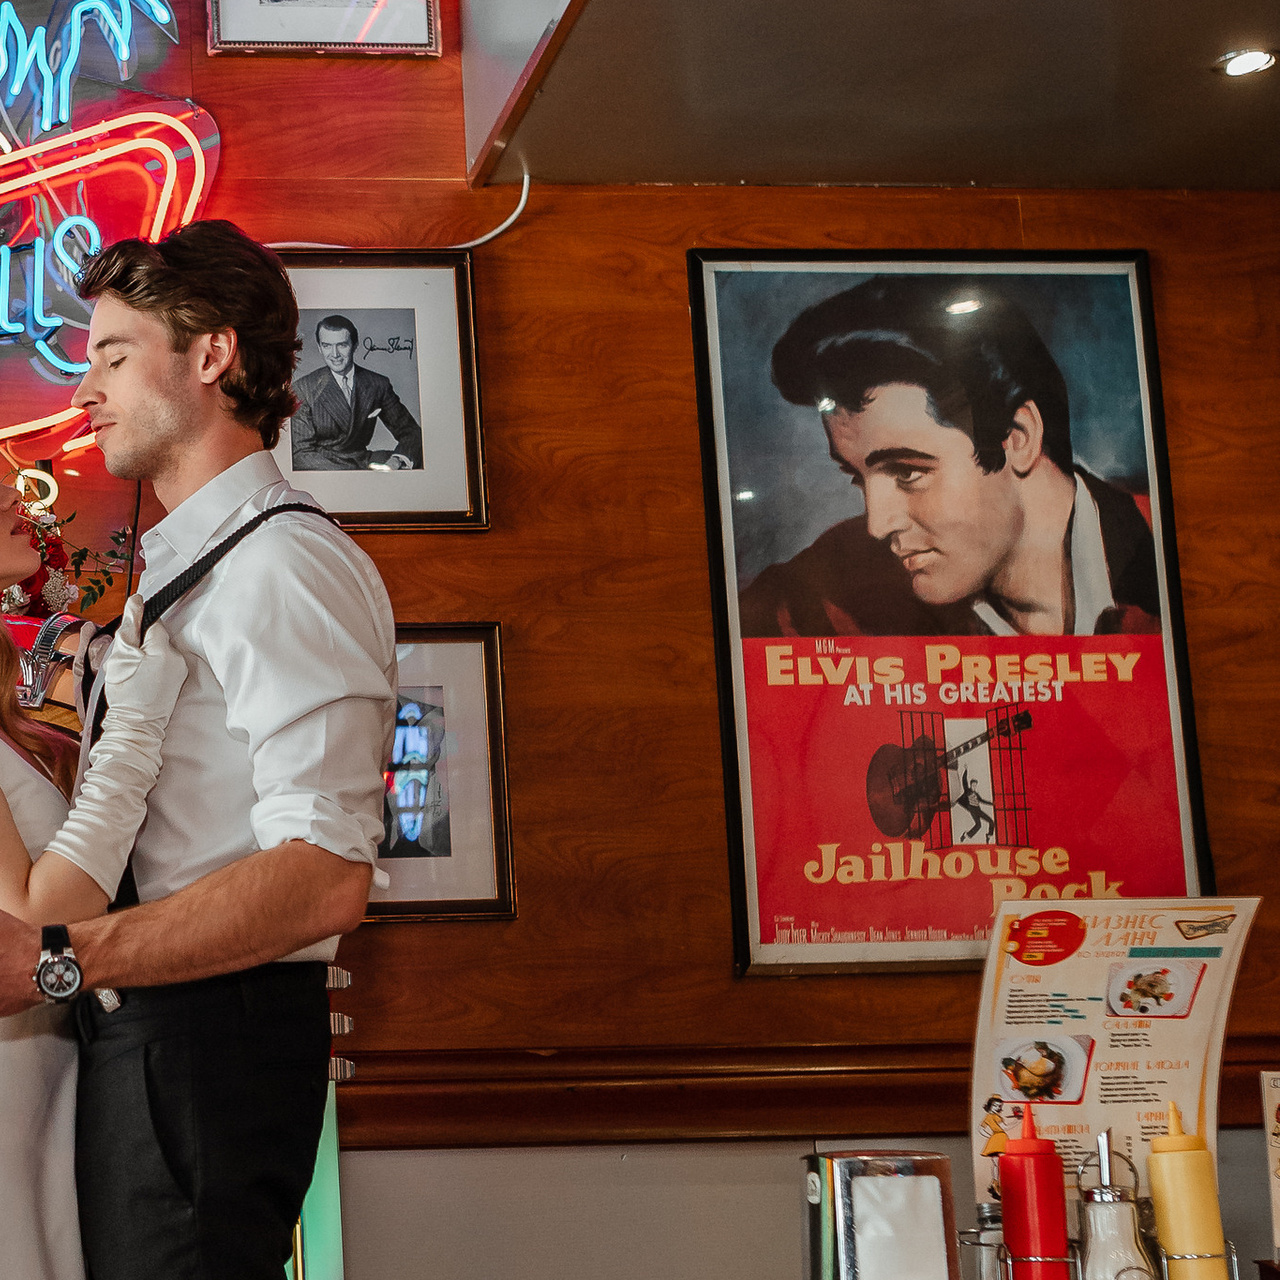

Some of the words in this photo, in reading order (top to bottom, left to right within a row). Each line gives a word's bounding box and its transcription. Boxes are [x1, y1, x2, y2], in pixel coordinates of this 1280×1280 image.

[765, 645, 905, 686] ELVIS
[925, 644, 1141, 685] PRESLEY
[843, 683, 874, 706] AT
[884, 682, 927, 706] HIS
[939, 680, 1064, 704] GREATEST
[803, 840, 1071, 885] Jailhouse
